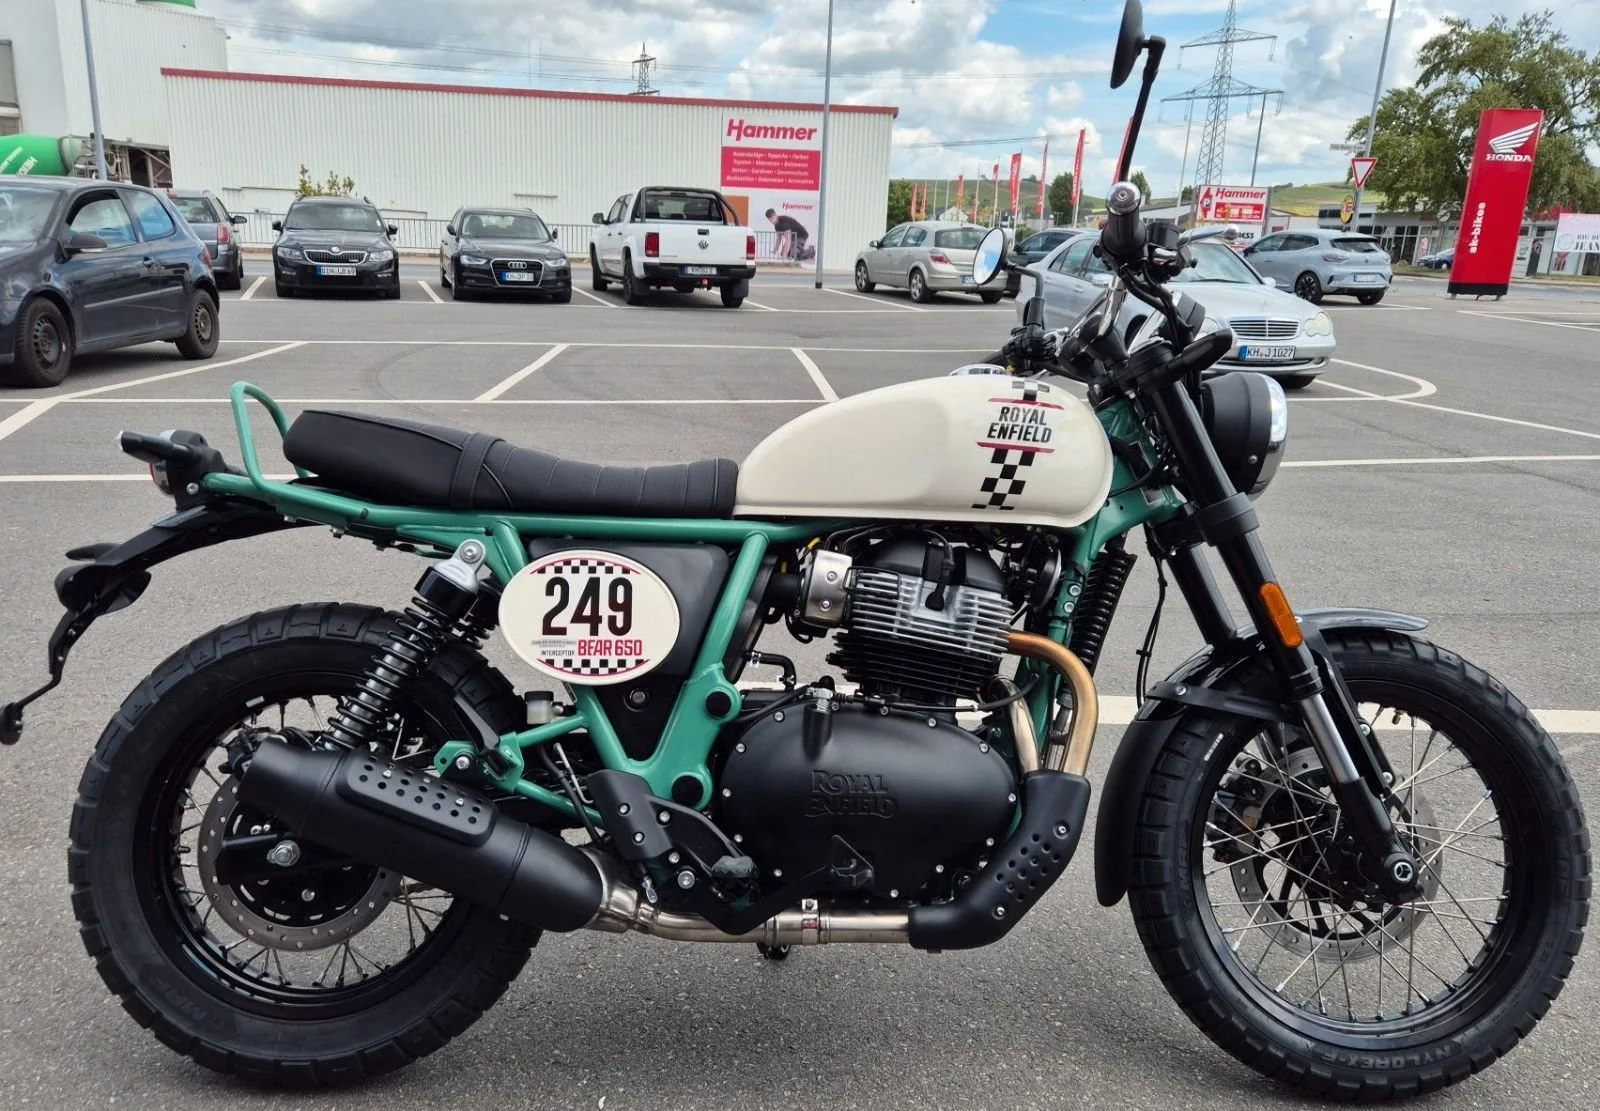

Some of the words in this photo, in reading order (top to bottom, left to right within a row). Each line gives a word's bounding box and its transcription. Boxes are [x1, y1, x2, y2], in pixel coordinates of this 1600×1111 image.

[726, 119, 817, 141] Hammer
[1485, 153, 1532, 162] HONDA
[1215, 187, 1266, 199] Hammer
[782, 202, 813, 211] Hammer
[1246, 346, 1259, 357] KH
[998, 406, 1047, 425] ROYAL
[987, 422, 1052, 443] ENFIELD
[541, 576, 633, 636] 249
[577, 639, 612, 657] BEAR
[614, 639, 642, 657] 650
[811, 769, 888, 795] ROYAL
[804, 795, 898, 818] ENFIELD
